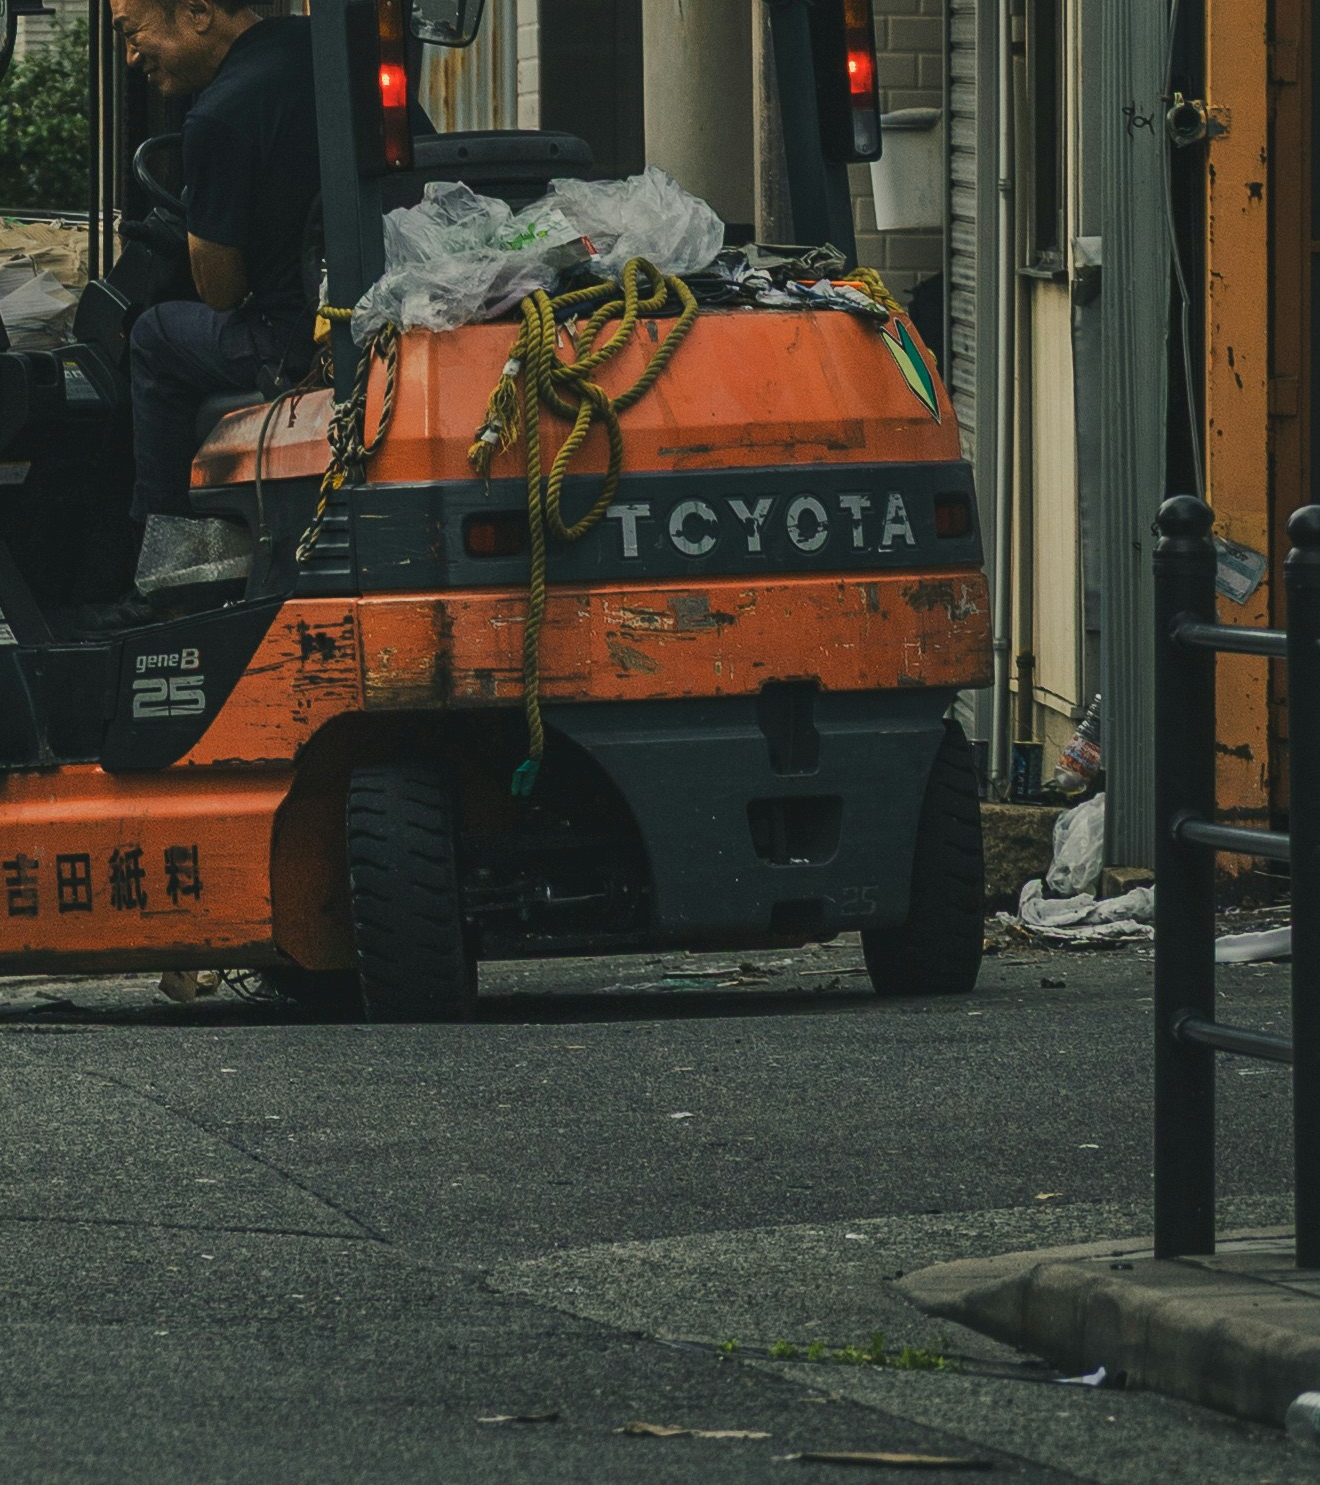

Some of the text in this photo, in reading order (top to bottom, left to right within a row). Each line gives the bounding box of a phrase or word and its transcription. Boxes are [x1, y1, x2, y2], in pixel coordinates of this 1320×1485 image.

[605, 492, 917, 558] TOYOTA
[136, 648, 200, 674] geneB
[132, 675, 207, 719] 25
[1, 842, 204, 917] 吉田紙料
